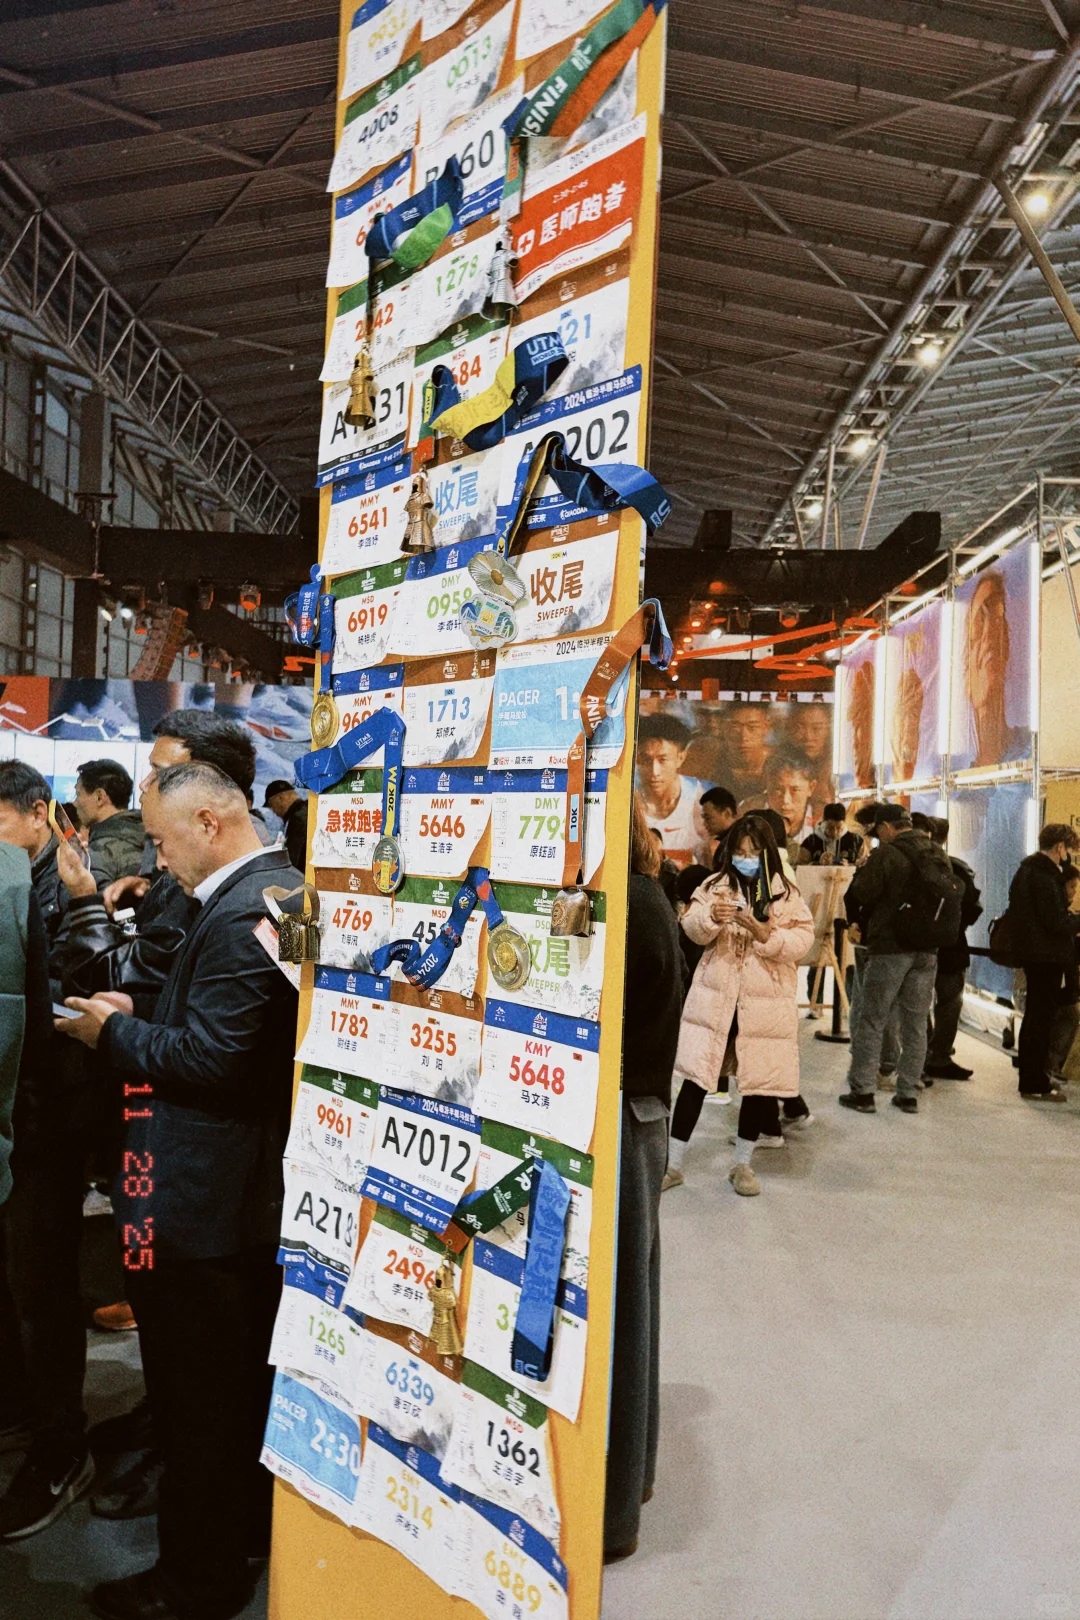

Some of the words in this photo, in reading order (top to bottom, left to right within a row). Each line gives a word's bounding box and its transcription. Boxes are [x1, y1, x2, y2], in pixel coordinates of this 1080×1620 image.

[358, 104, 399, 143] 4008
[539, 180, 626, 247] 医师跑者
[436, 254, 479, 297] 1278
[355, 302, 395, 342] 242
[330, 382, 405, 445] A31
[360, 494, 380, 509] MMY
[435, 471, 479, 515] 收尾
[348, 506, 388, 537] 6541
[438, 512, 471, 530] SWEEPER
[441, 573, 461, 588] DMY
[530, 560, 584, 606] 收尾
[361, 595, 375, 605] MSD
[347, 603, 388, 633] 6919
[537, 605, 574, 622] SWEEPER
[556, 635, 614, 656] 2024临汾半程马
[353, 695, 372, 707] MMY
[427, 696, 471, 723] 1713
[498, 689, 540, 707] PACER
[342, 709, 380, 733] 960
[497, 710, 528, 721] 半程马拉松
[351, 797, 364, 805] MSD
[430, 798, 455, 809] MMY
[535, 798, 560, 809] DMY
[325, 809, 383, 833] 急救跑者
[419, 814, 465, 838] 5646
[519, 815, 565, 840] 779
[332, 907, 373, 932] 4769
[431, 909, 447, 919] MSD
[535, 919, 551, 930] DSD
[418, 952, 439, 977] 2024
[527, 977, 560, 993] WEEPER
[341, 997, 359, 1010] MMY
[331, 1011, 368, 1039] 1782
[410, 1023, 457, 1057] 3255
[525, 1040, 552, 1058] KMY
[509, 1055, 565, 1095] 5648
[520, 1089, 550, 1110] 马文涛
[317, 1104, 352, 1138] 9961
[381, 1116, 471, 1182] A7012
[408, 1244, 423, 1258] MSD
[383, 1249, 436, 1291] 2496
[308, 1314, 345, 1355] 1265
[385, 1362, 434, 1406] 6339
[274, 1393, 308, 1423] PACER
[505, 1416, 523, 1433] MSD
[310, 1418, 361, 1476] 2:30
[487, 1420, 540, 1477] 1362
[385, 1476, 433, 1530] 2314
[484, 1549, 541, 1613] 6889
